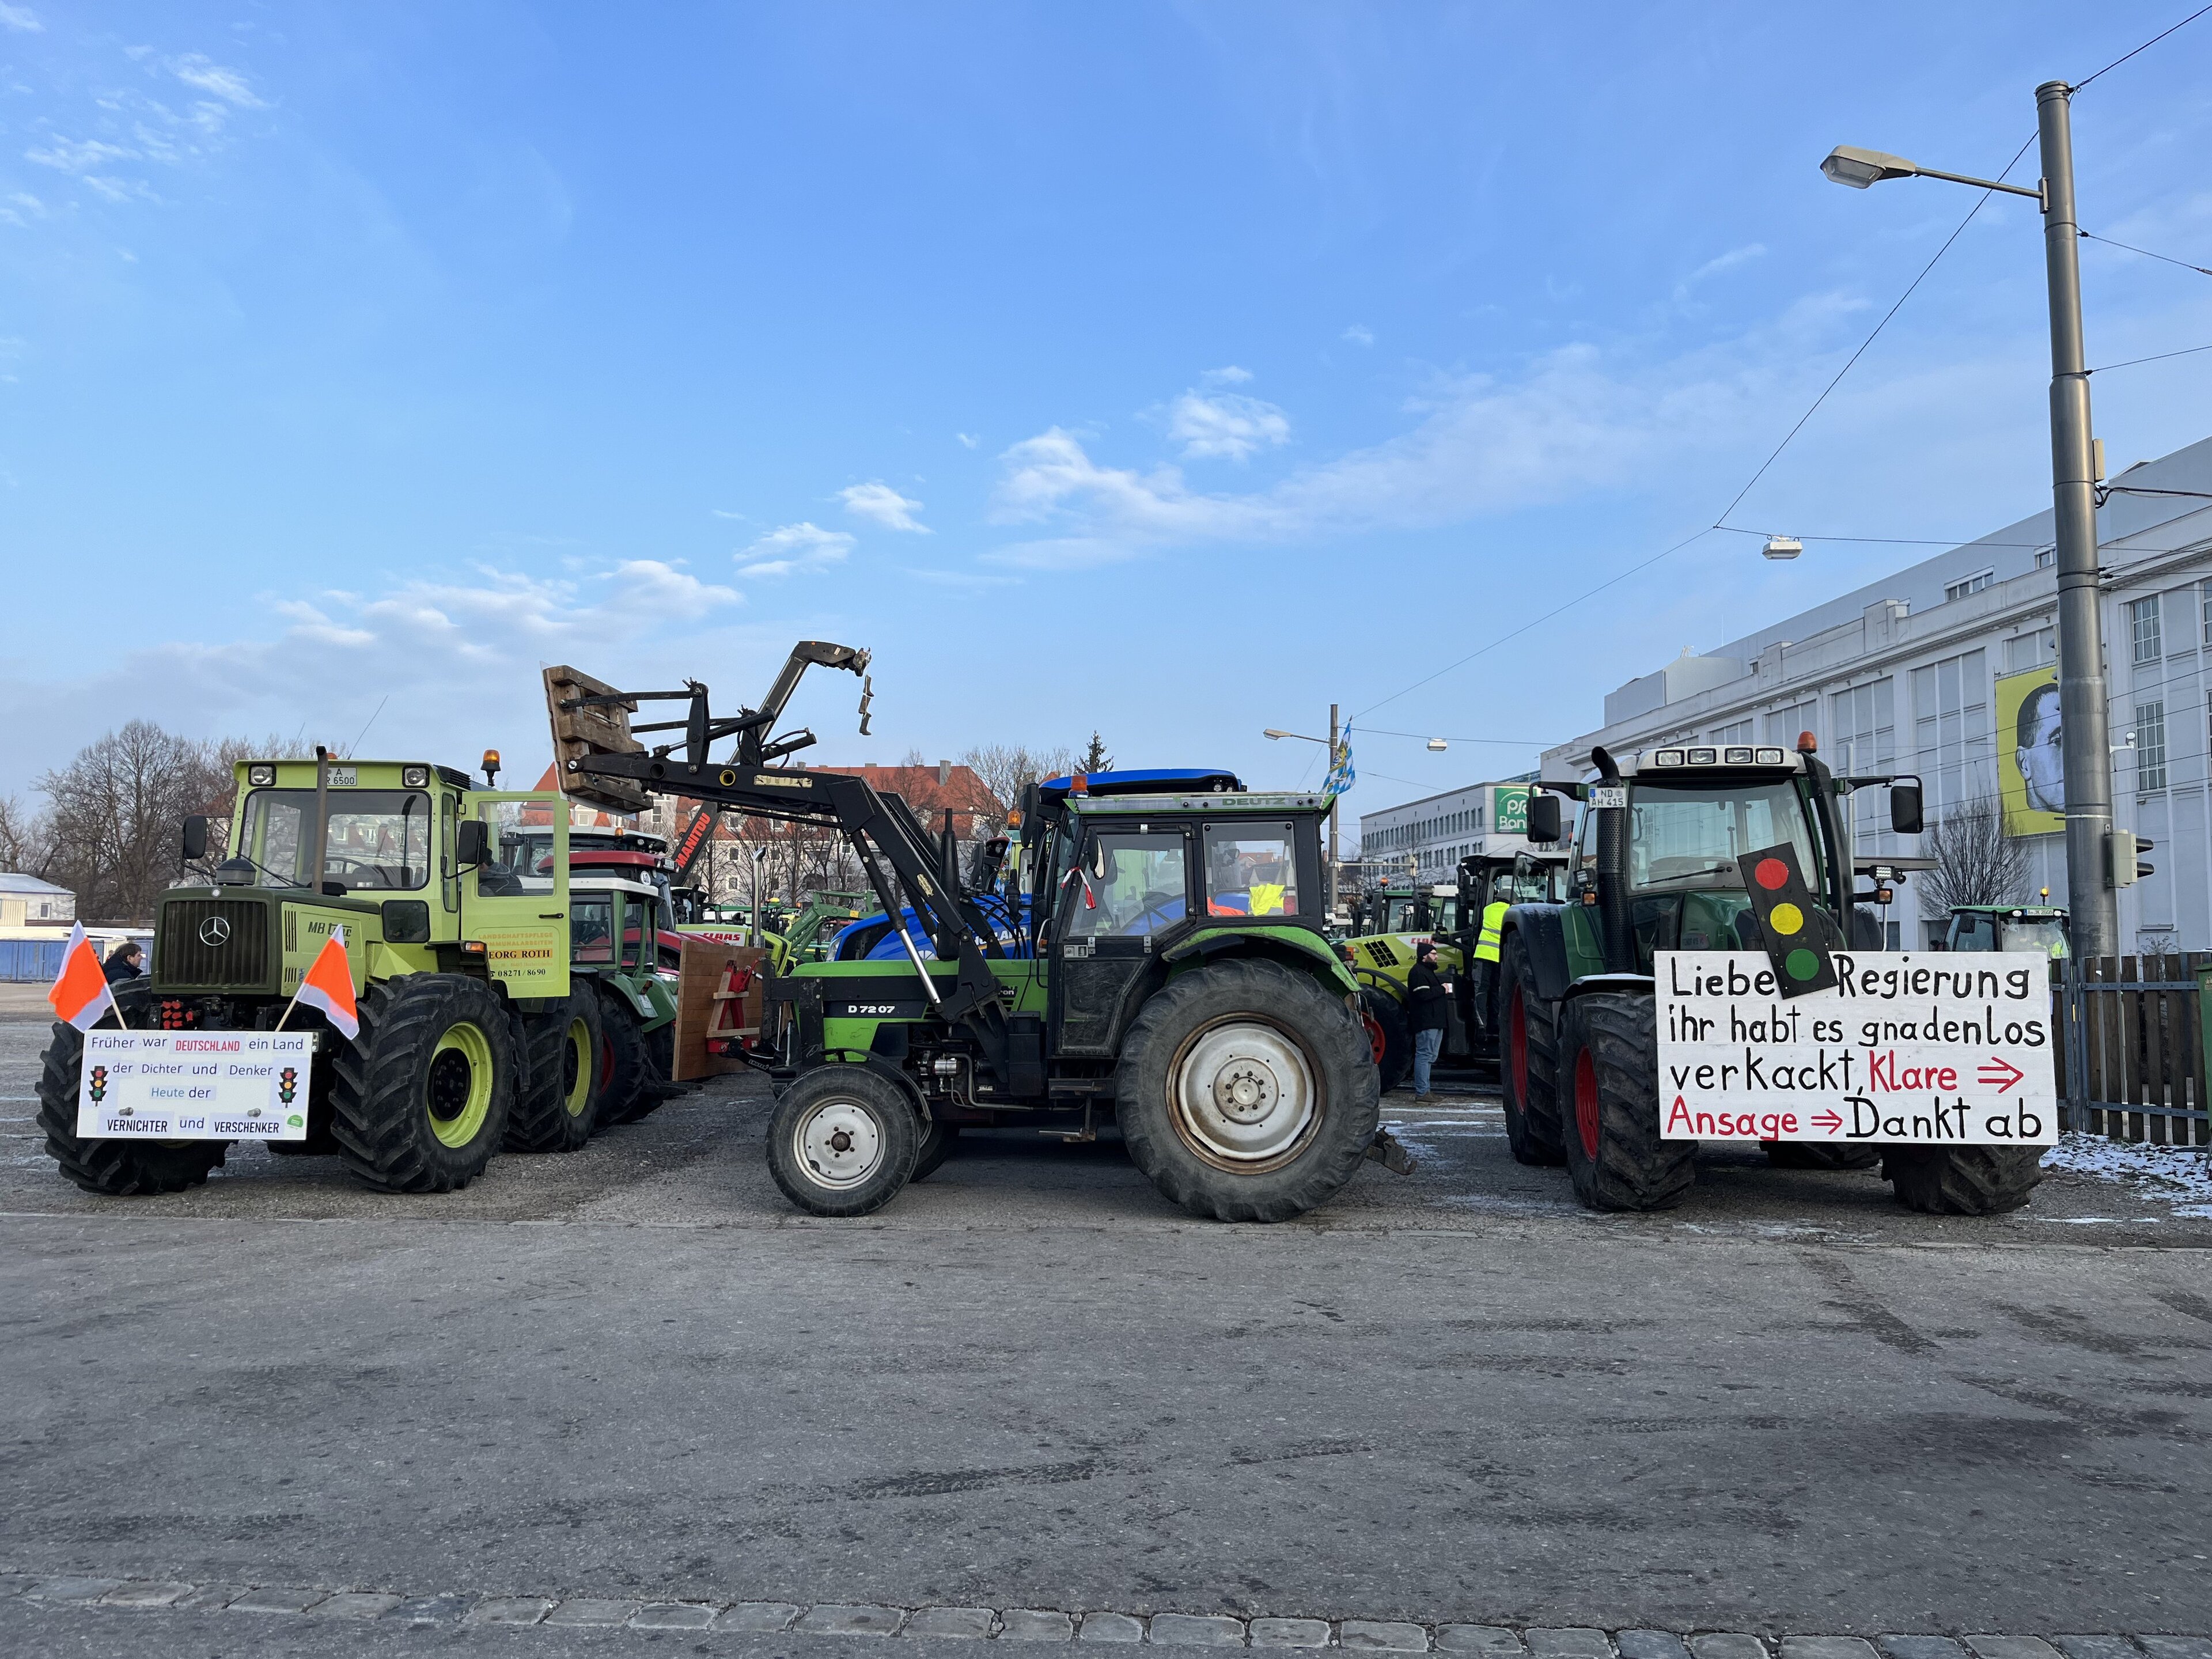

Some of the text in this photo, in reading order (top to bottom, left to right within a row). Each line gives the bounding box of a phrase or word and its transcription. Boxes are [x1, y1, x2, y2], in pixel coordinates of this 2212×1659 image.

[336, 768, 343, 776] A
[334, 777, 354, 785] 6500
[1600, 789, 1613, 797] ND
[1222, 797, 1285, 806] DEUTZ
[1499, 815, 1527, 829] Ban
[675, 812, 711, 868] MANITOU
[308, 921, 325, 934] MB
[488, 949, 550, 959] EORG ROTH
[1671, 953, 2030, 999] Liebe Regierung
[1669, 1003, 2046, 1047] ihr habt es gnadenlos
[92, 1037, 304, 1052] Früher war DEUTSCHLAND ein Land
[113, 1062, 274, 1075] der Dichter und Denker
[1869, 1050, 1957, 1092] Klare
[151, 1086, 211, 1099] Heute der
[1667, 1094, 2041, 1141] Ansage Dankt ab
[107, 1119, 168, 1132] VERNICHTER
[180, 1117, 204, 1129] und
[214, 1121, 280, 1134] VERSCHENKER
